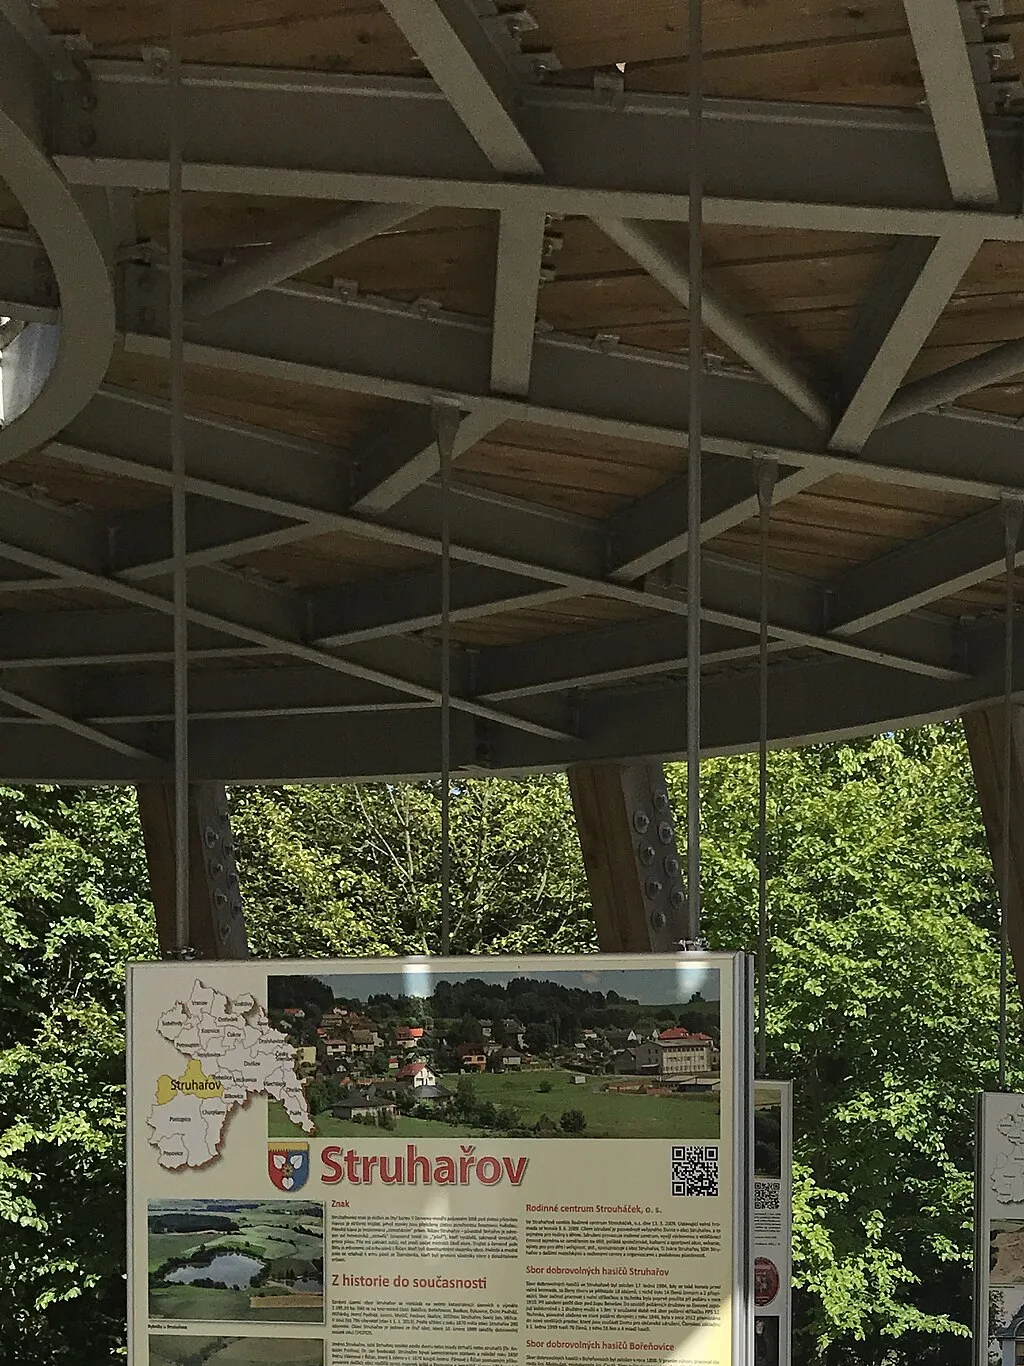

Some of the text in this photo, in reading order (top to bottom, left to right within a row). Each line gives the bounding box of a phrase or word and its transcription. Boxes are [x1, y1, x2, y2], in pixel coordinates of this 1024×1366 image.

[170, 1079, 222, 1090] Struhařov
[321, 1144, 527, 1184] Struhařov
[332, 1200, 350, 1208] Znak
[526, 1204, 558, 1212] Rodinné
[596, 1204, 644, 1214] Strouháček,
[526, 1265, 669, 1276] Sbor dobrovolných hasičů Struhařov
[332, 1274, 486, 1289] Z historie do současnosti
[526, 1339, 674, 1351] Sbor dobrovolných hasičů Bořeňovice
